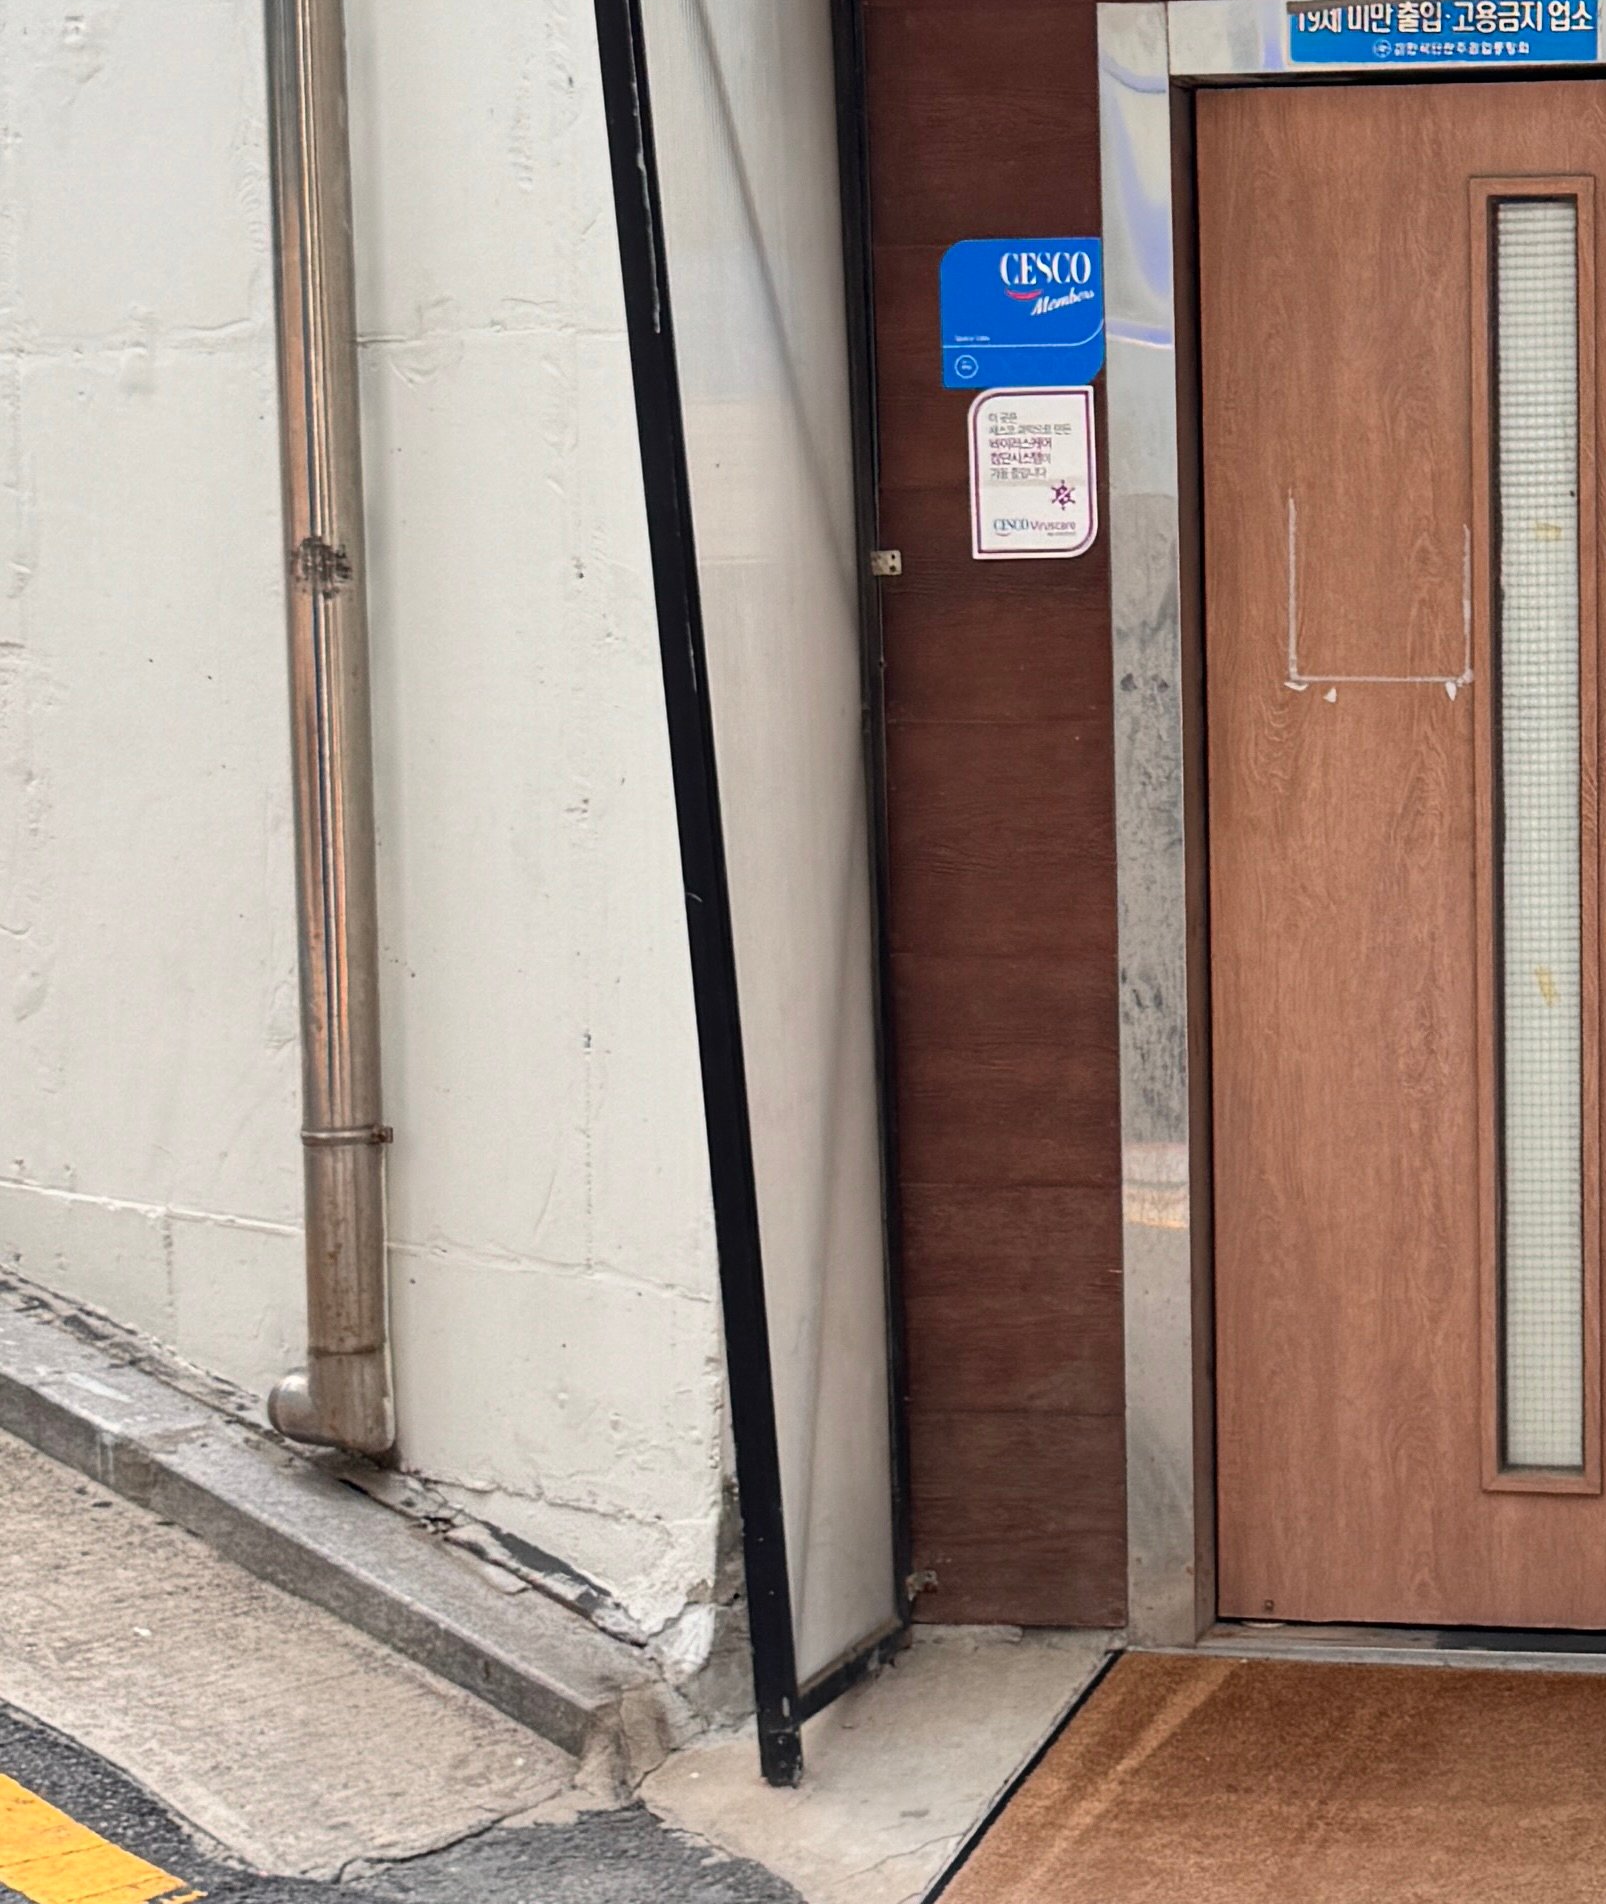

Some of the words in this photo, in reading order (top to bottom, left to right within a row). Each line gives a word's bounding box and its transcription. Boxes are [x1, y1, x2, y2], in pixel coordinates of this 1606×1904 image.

[1298, 7, 1342, 34] 19세
[1347, 2, 1394, 34] 미만
[1548, 0, 1594, 33] 업소
[1000, 251, 1092, 286] CESCO
